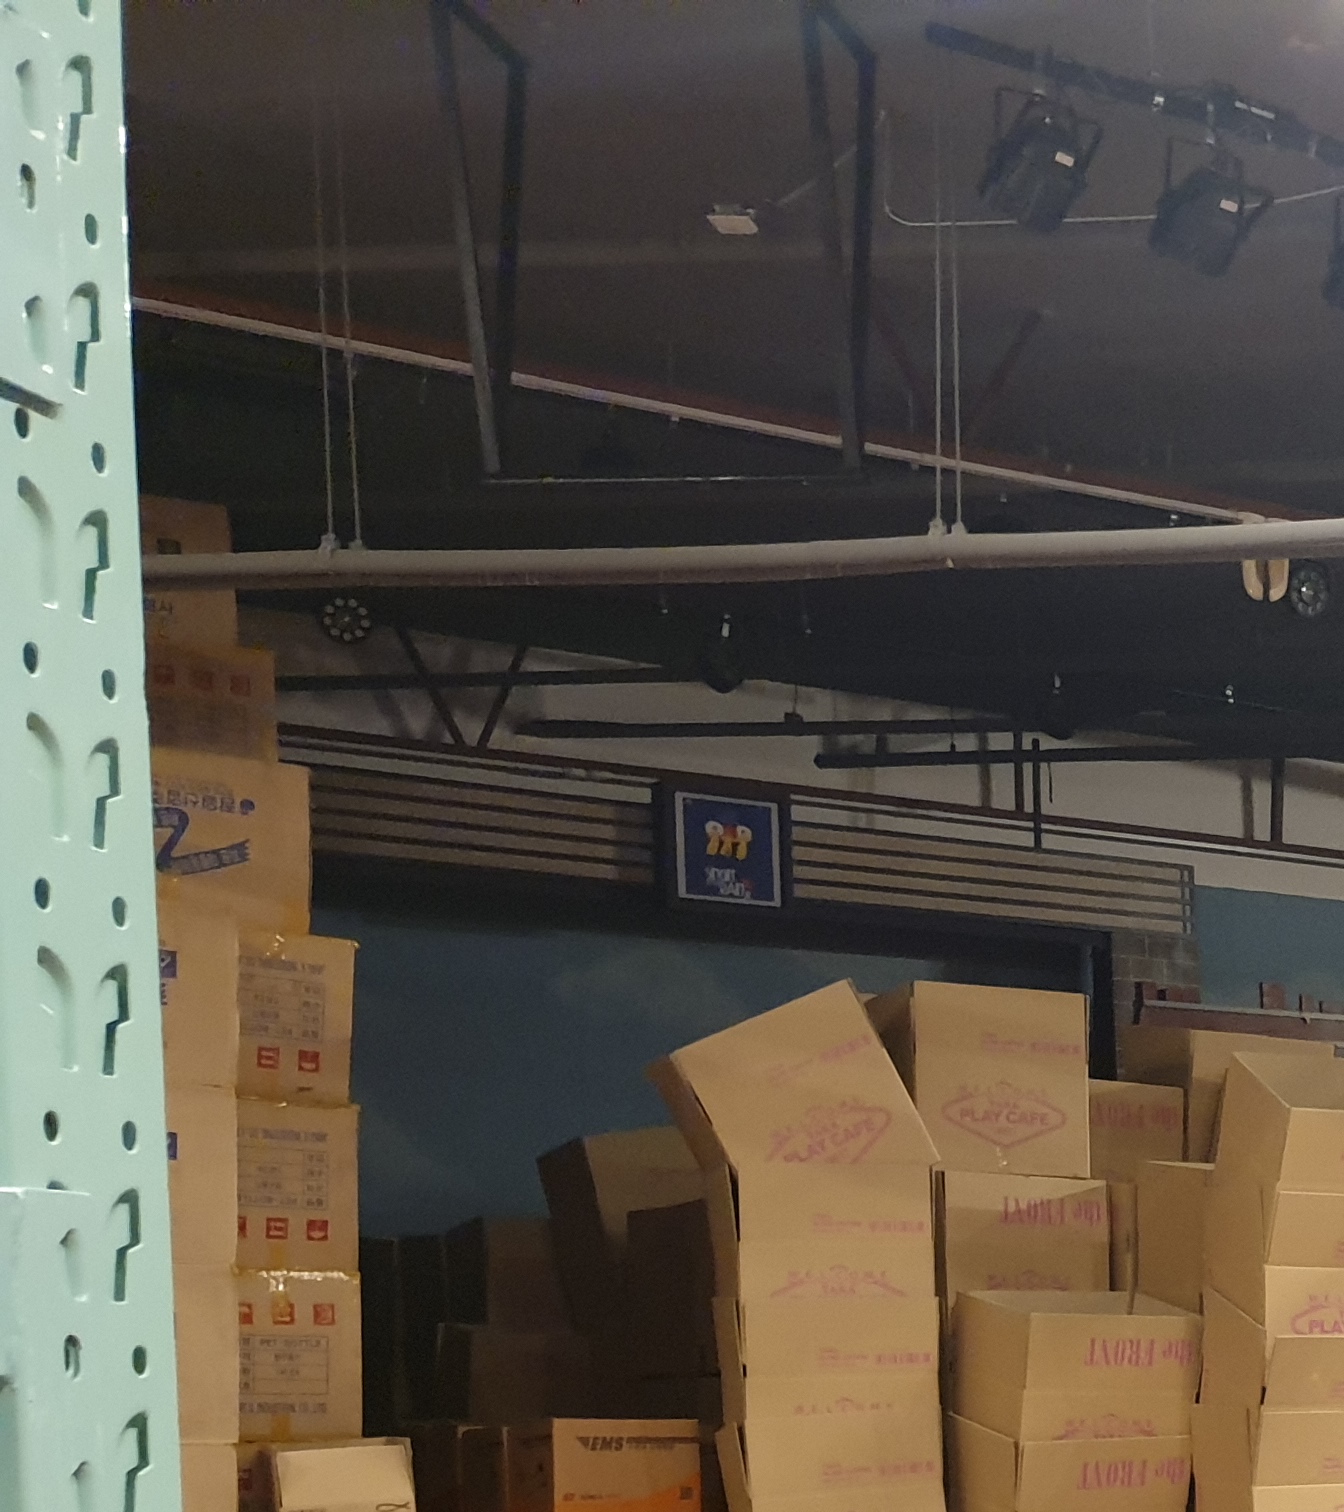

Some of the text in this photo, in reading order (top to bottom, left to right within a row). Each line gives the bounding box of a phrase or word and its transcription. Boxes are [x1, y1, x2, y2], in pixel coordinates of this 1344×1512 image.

[1006, 1111, 1050, 1126] CAFE
[1084, 1337, 1155, 1368] FRONT
[590, 1436, 625, 1452] EMS
